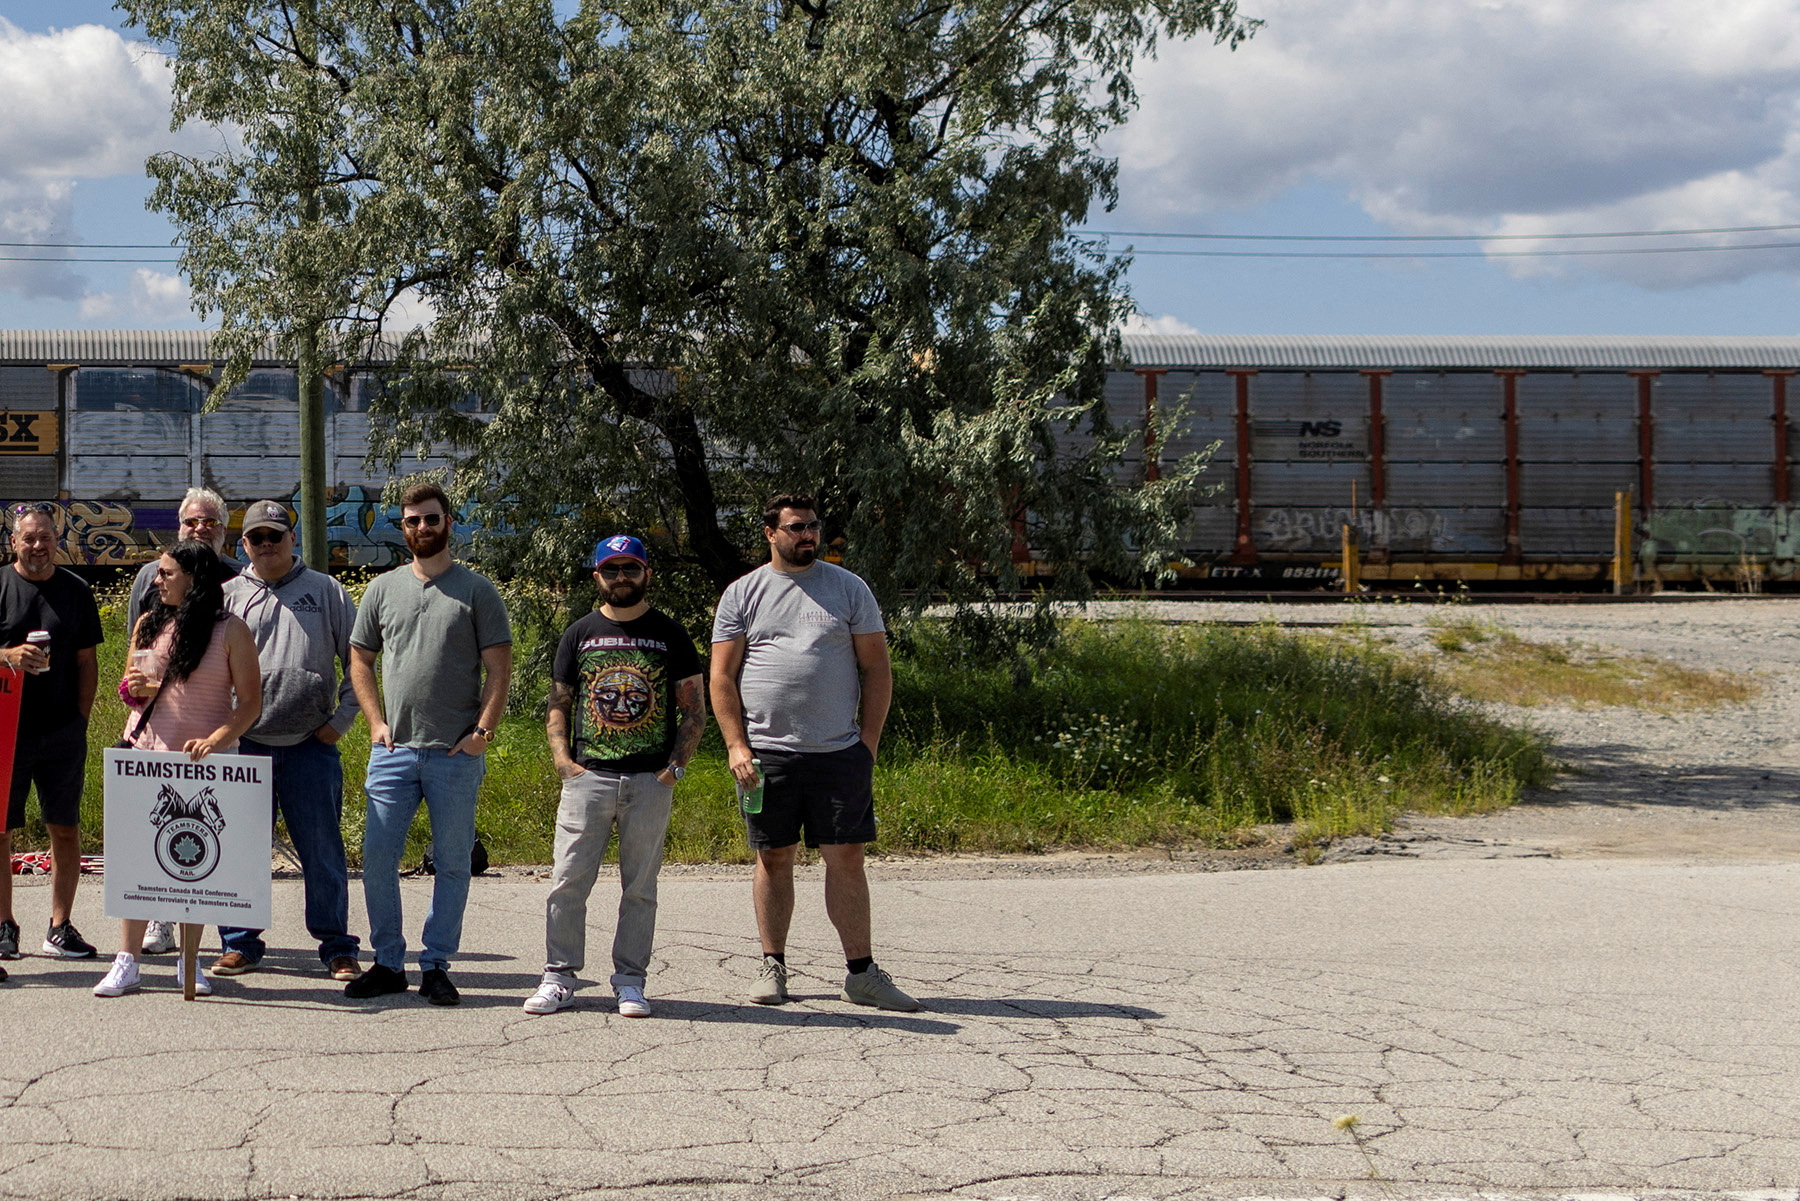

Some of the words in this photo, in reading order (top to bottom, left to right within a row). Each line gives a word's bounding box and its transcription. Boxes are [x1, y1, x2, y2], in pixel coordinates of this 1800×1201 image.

[1300, 421, 1342, 437] NS
[1282, 566, 1340, 578] 852114
[290, 605, 322, 613] adidas
[578, 638, 668, 651] SUBLIME
[114, 760, 216, 781] TEAMSTERS
[222, 765, 262, 784] RAIL
[166, 822, 208, 838] TEAMSTERS
[138, 884, 167, 893] Teamsters
[205, 889, 238, 898] Conference
[124, 893, 156, 902] Conférence
[157, 896, 188, 904] ferroviaire
[198, 899, 228, 907] Teamsters
